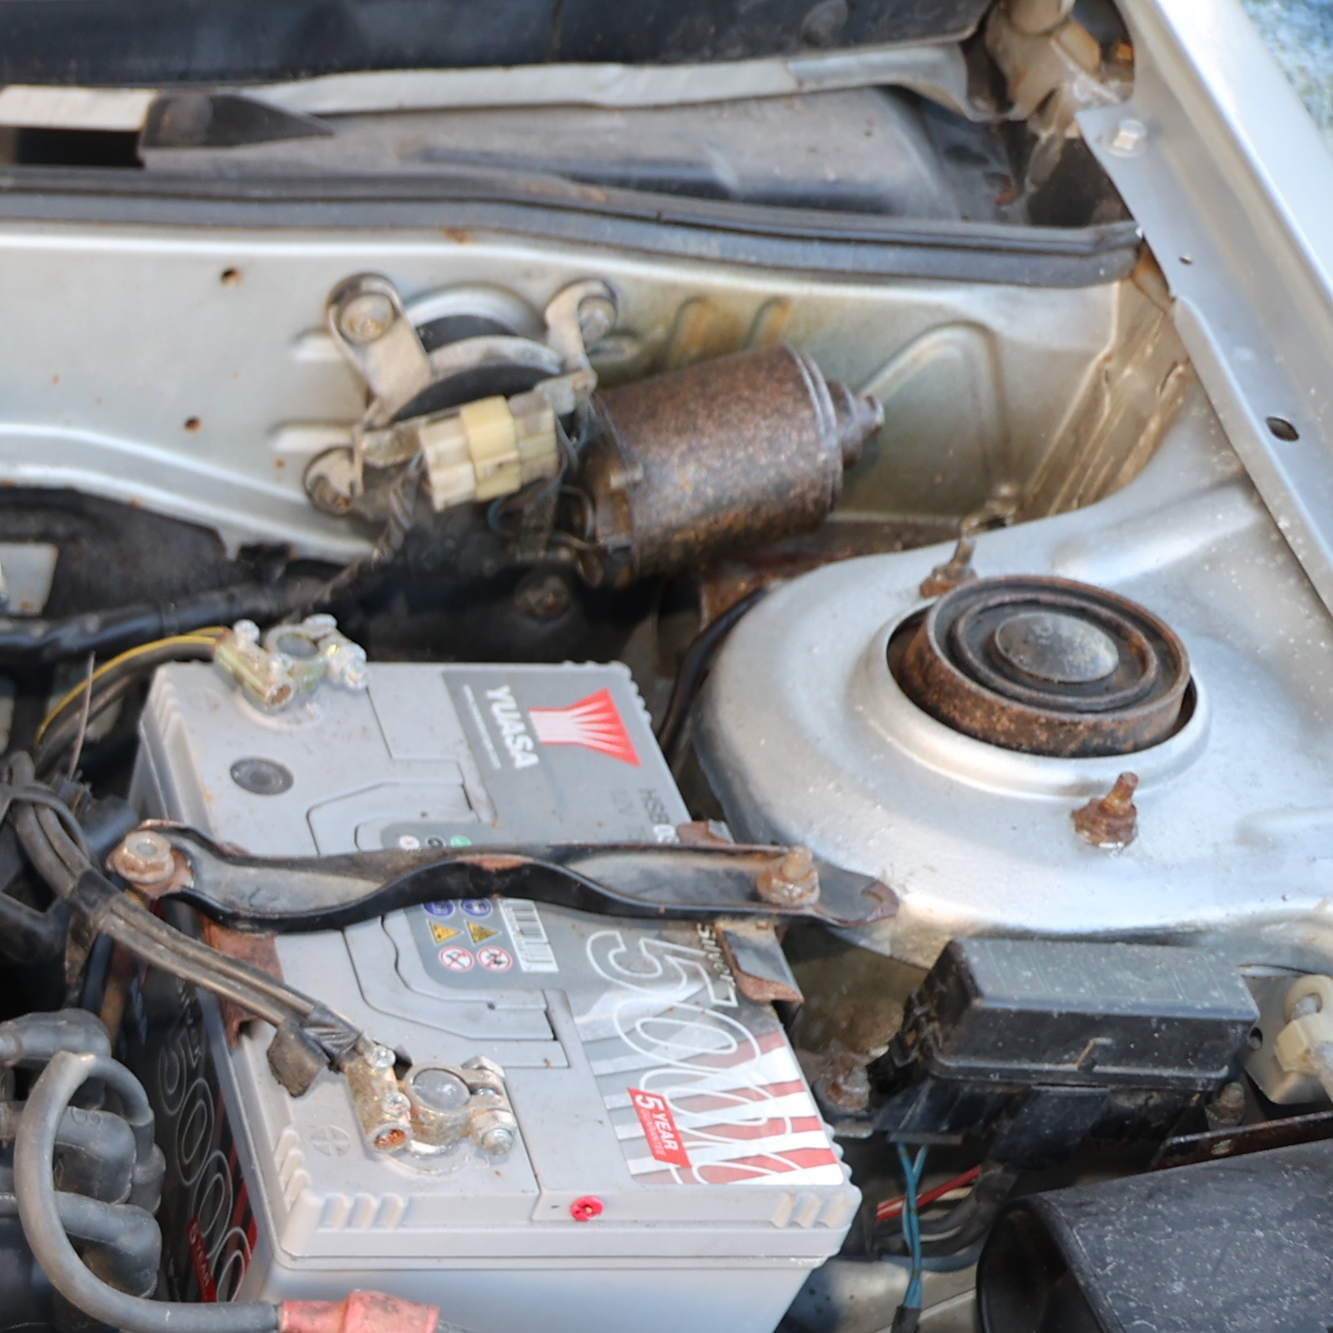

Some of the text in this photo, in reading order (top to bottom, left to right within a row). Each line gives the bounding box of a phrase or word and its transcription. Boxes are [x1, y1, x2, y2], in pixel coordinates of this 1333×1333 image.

[486, 685, 539, 769] YUASA
[697, 923, 735, 985] Silver
[635, 1094, 680, 1151] 5 YEAR
